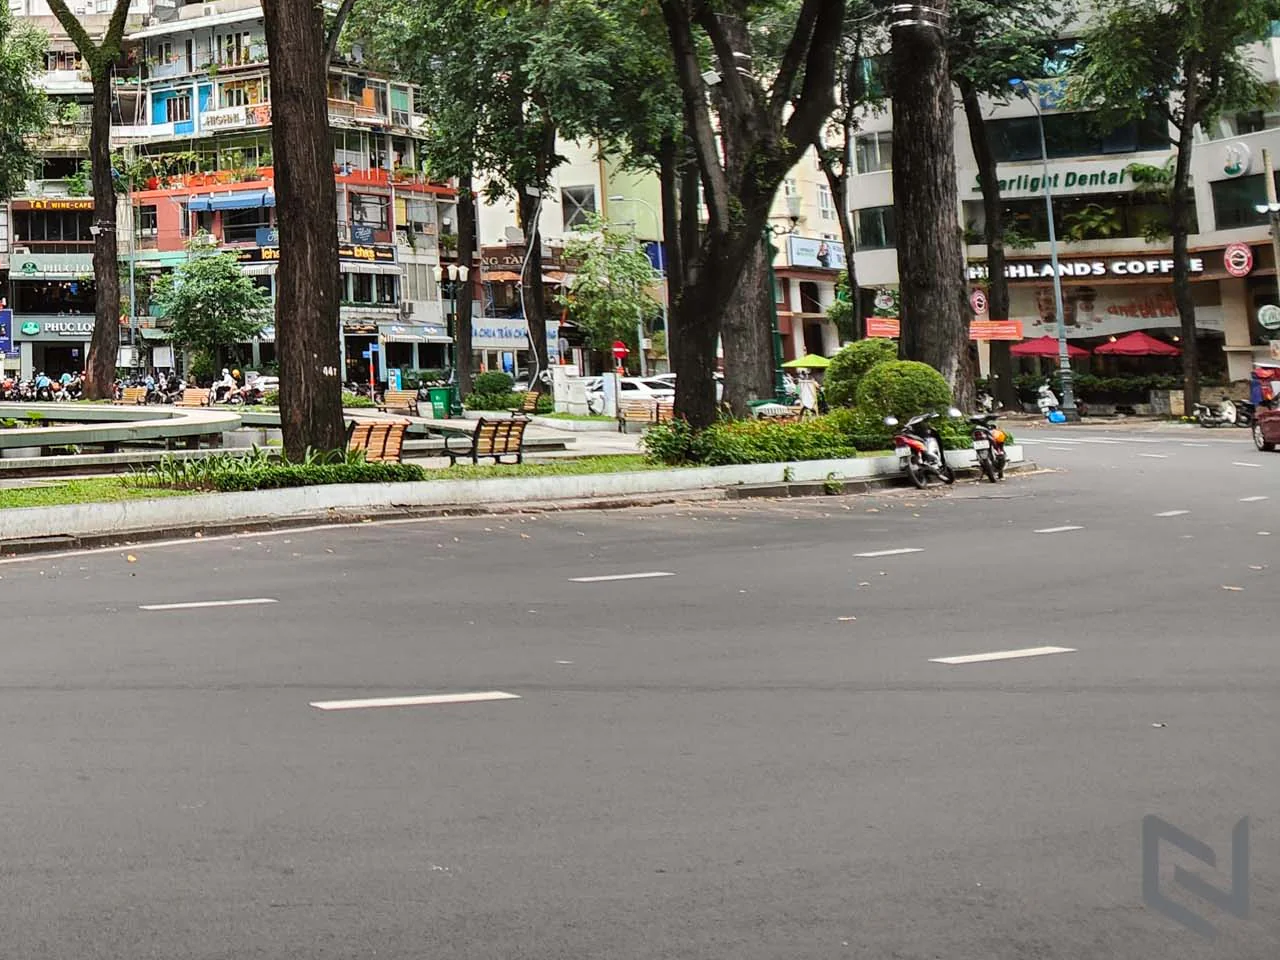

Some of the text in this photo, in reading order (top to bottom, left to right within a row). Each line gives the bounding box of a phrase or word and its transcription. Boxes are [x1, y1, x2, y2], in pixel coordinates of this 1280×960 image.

[971, 173, 1060, 193] Sarlight
[1064, 168, 1124, 188] Dental
[29, 199, 48, 209] T&T
[966, 261, 1106, 280] HIHLANDS
[1111, 257, 1204, 275] COFFE
